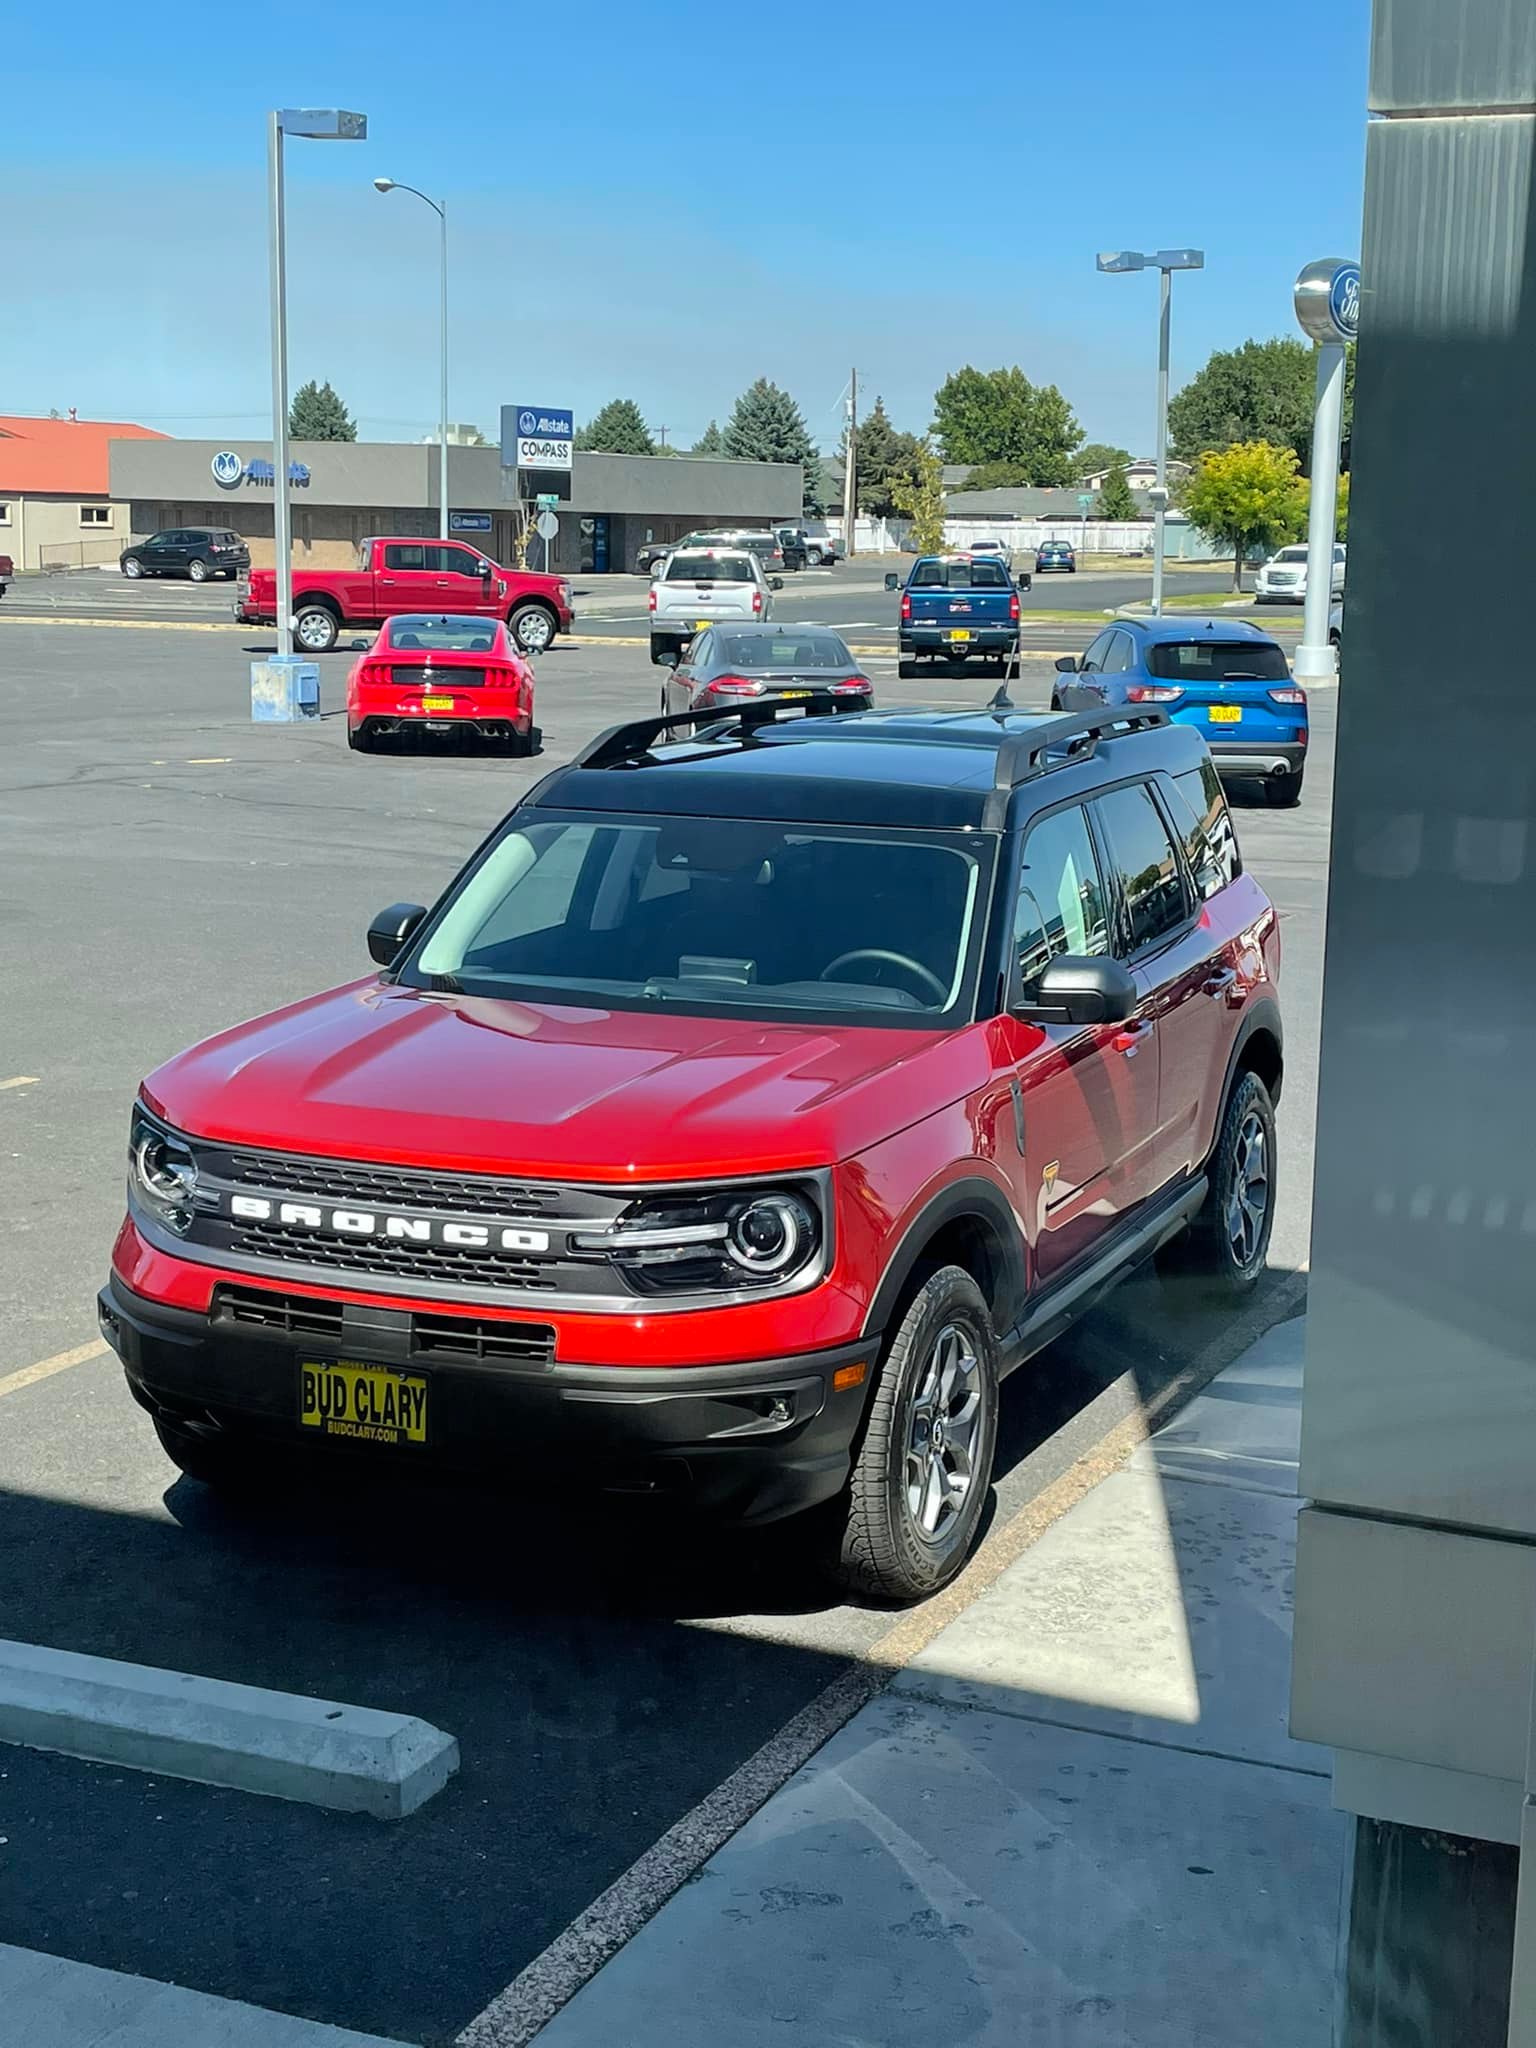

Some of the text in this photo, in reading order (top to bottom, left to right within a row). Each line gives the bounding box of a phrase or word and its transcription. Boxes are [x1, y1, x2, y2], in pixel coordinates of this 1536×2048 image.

[521, 441, 568, 458] COMPASS
[231, 1195, 549, 1252] BRONCO
[303, 1371, 426, 1430] BUD CLARY
[327, 1421, 398, 1443] BUDCLARY.COM
